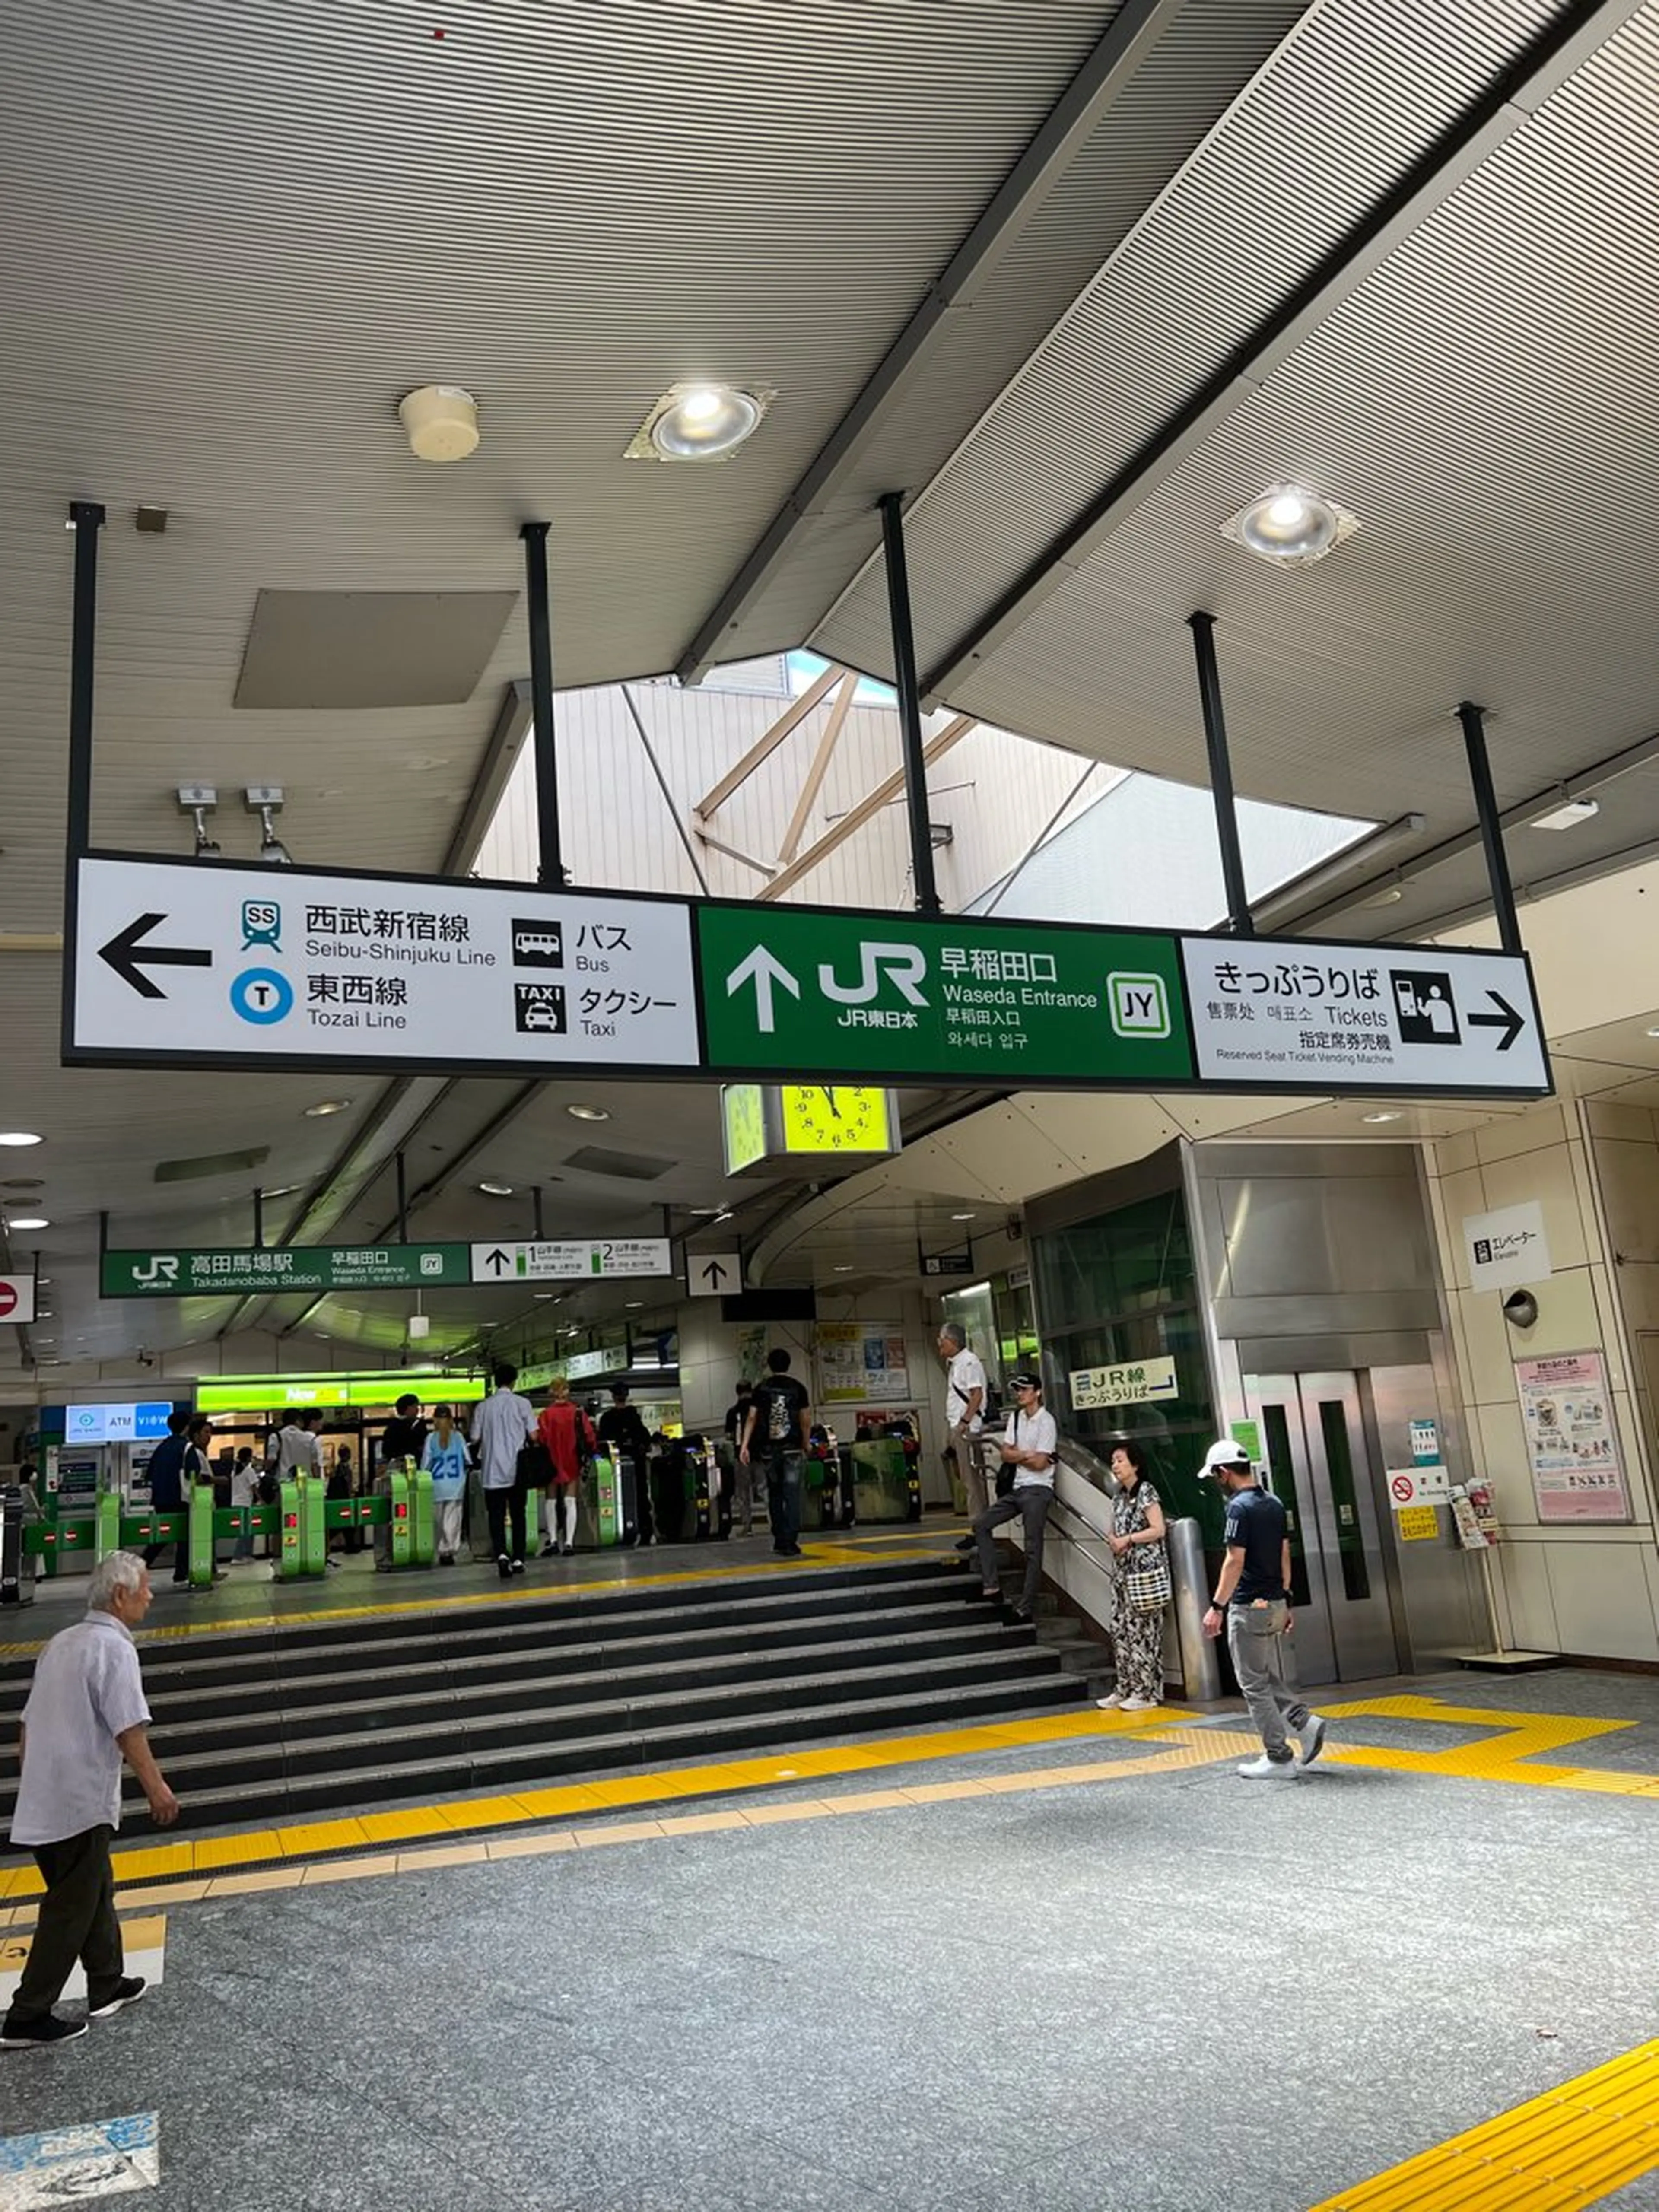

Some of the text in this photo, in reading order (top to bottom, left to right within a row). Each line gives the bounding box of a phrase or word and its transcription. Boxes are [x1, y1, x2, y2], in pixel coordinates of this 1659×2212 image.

[248, 908, 275, 924] SS
[305, 904, 470, 942] 西武新宿線
[576, 924, 632, 951] バス
[305, 939, 496, 966] Seibu-Shinjuku Line
[576, 955, 610, 973] Bus
[818, 941, 931, 1007] JR
[941, 947, 1057, 983] 早稲田口
[307, 973, 407, 1006] 東西線
[1214, 961, 1381, 1000] きっぷうりば
[254, 987, 269, 1005] T
[518, 986, 560, 1001] TAXI
[580, 988, 677, 1014] タクシー
[942, 984, 1097, 1008] Waseda Entrance
[1124, 992, 1153, 1017] JY
[1267, 1004, 1313, 1021] 매표소
[307, 1009, 406, 1029] Tozai Line
[837, 1009, 918, 1029] JR東日本
[1325, 1006, 1388, 1027] Tickets
[580, 1020, 616, 1036] Taxi
[947, 1031, 1029, 1050] 와세다 입구
[1299, 1031, 1392, 1052] 指定席券売機
[1216, 1049, 1394, 1065] Reserved Seat Ticket Vending Machine
[1492, 1230, 1536, 1250] エレベーター
[331, 1252, 388, 1265] 早稲田口
[529, 1246, 536, 1262] 1
[603, 1243, 614, 1260] 2
[132, 1255, 180, 1281] JR
[191, 1253, 292, 1274] 高田馬場駅
[331, 1265, 406, 1275] Waseda Entrance
[191, 1273, 321, 1287] Takadanobaba Station
[1092, 1367, 1146, 1388] JR線
[110, 1417, 131, 1426] ATM
[432, 1454, 460, 1479] 23
